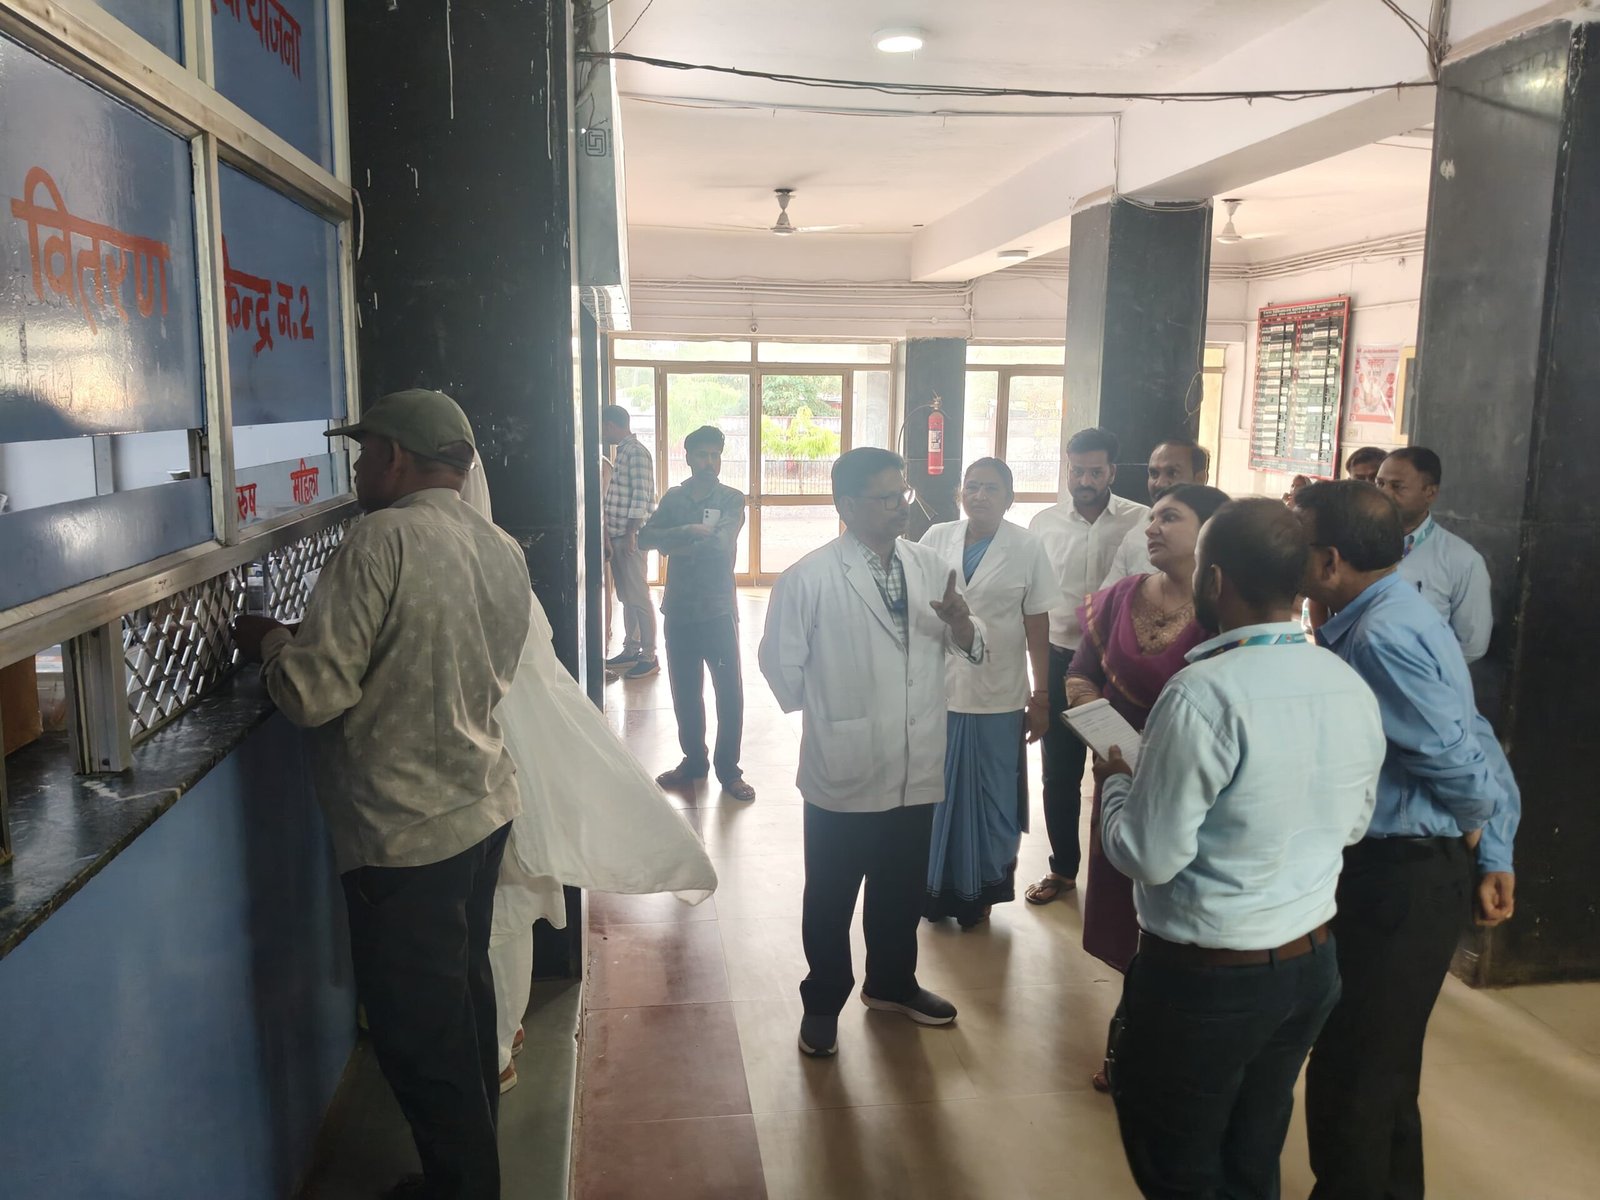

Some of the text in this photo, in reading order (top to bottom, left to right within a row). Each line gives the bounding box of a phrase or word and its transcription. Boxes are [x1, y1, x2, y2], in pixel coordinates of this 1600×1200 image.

[10, 166, 170, 336] वितरण
[235, 483, 257, 521] रुष
[290, 457, 319, 505] महिला
